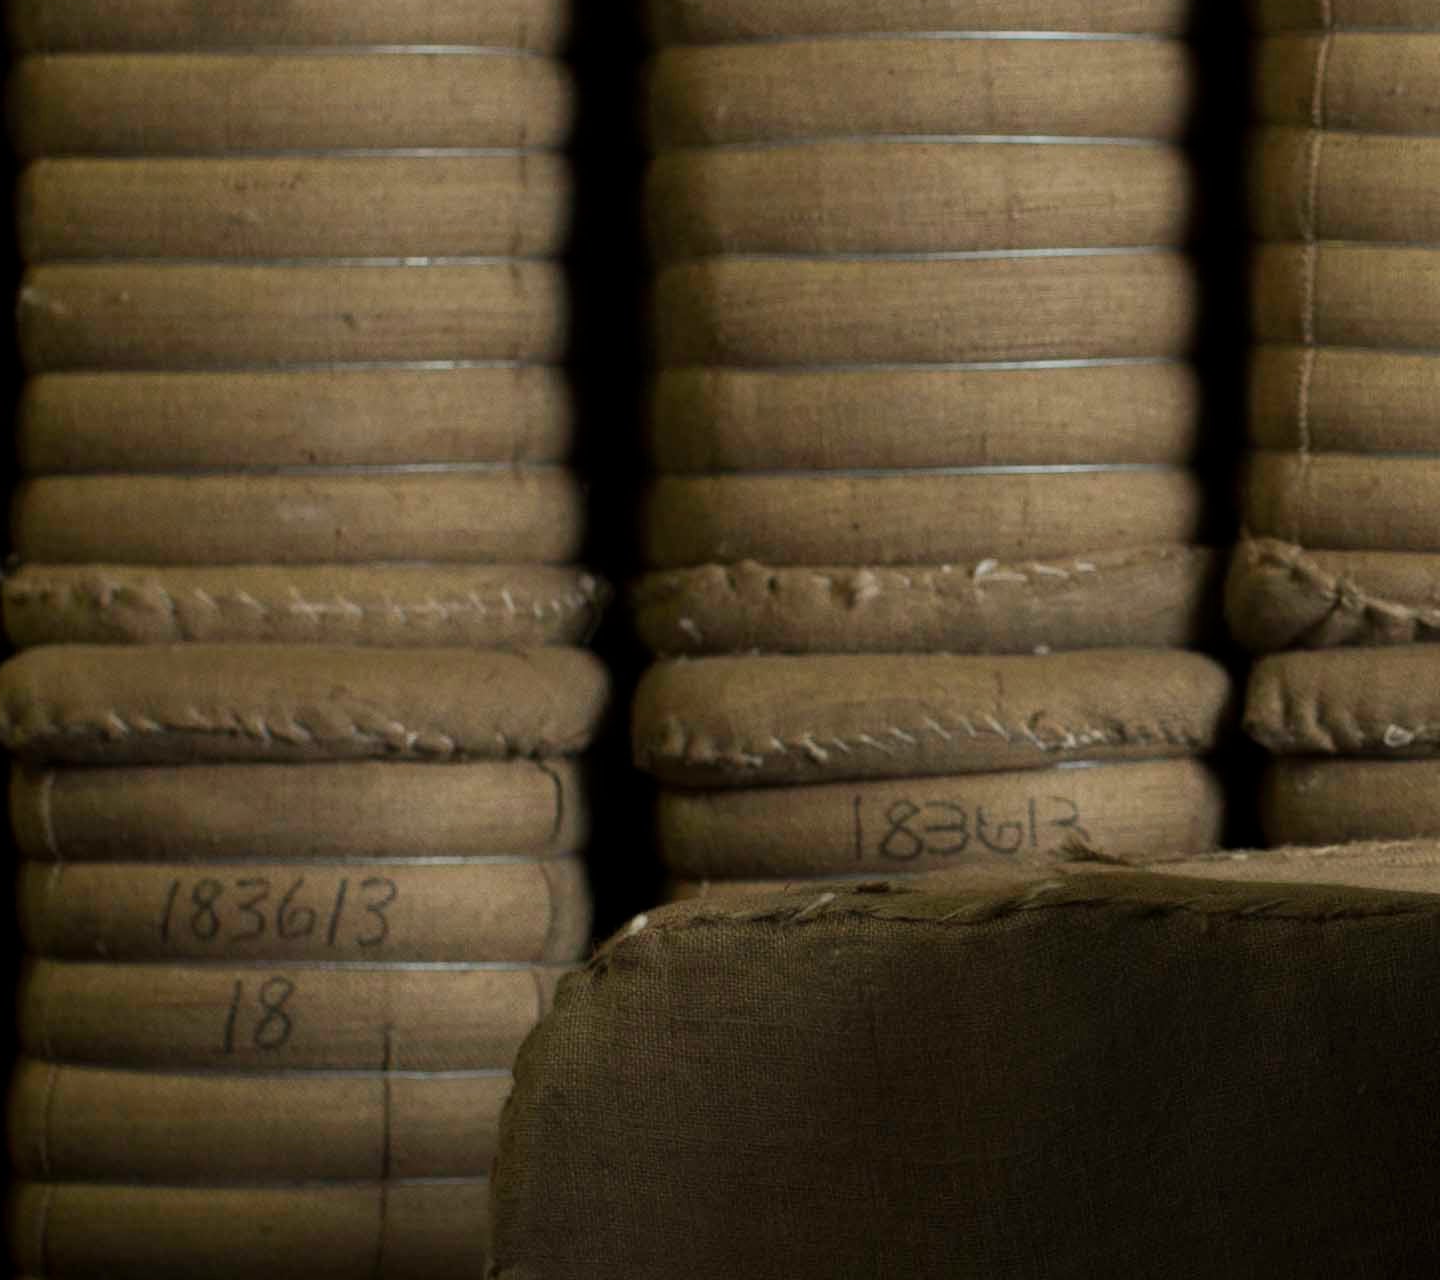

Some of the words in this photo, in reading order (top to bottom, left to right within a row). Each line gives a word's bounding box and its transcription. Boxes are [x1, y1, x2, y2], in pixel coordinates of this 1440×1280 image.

[854, 794, 1093, 864] 183613
[160, 877, 398, 948] 183613
[221, 977, 296, 1055] 18
